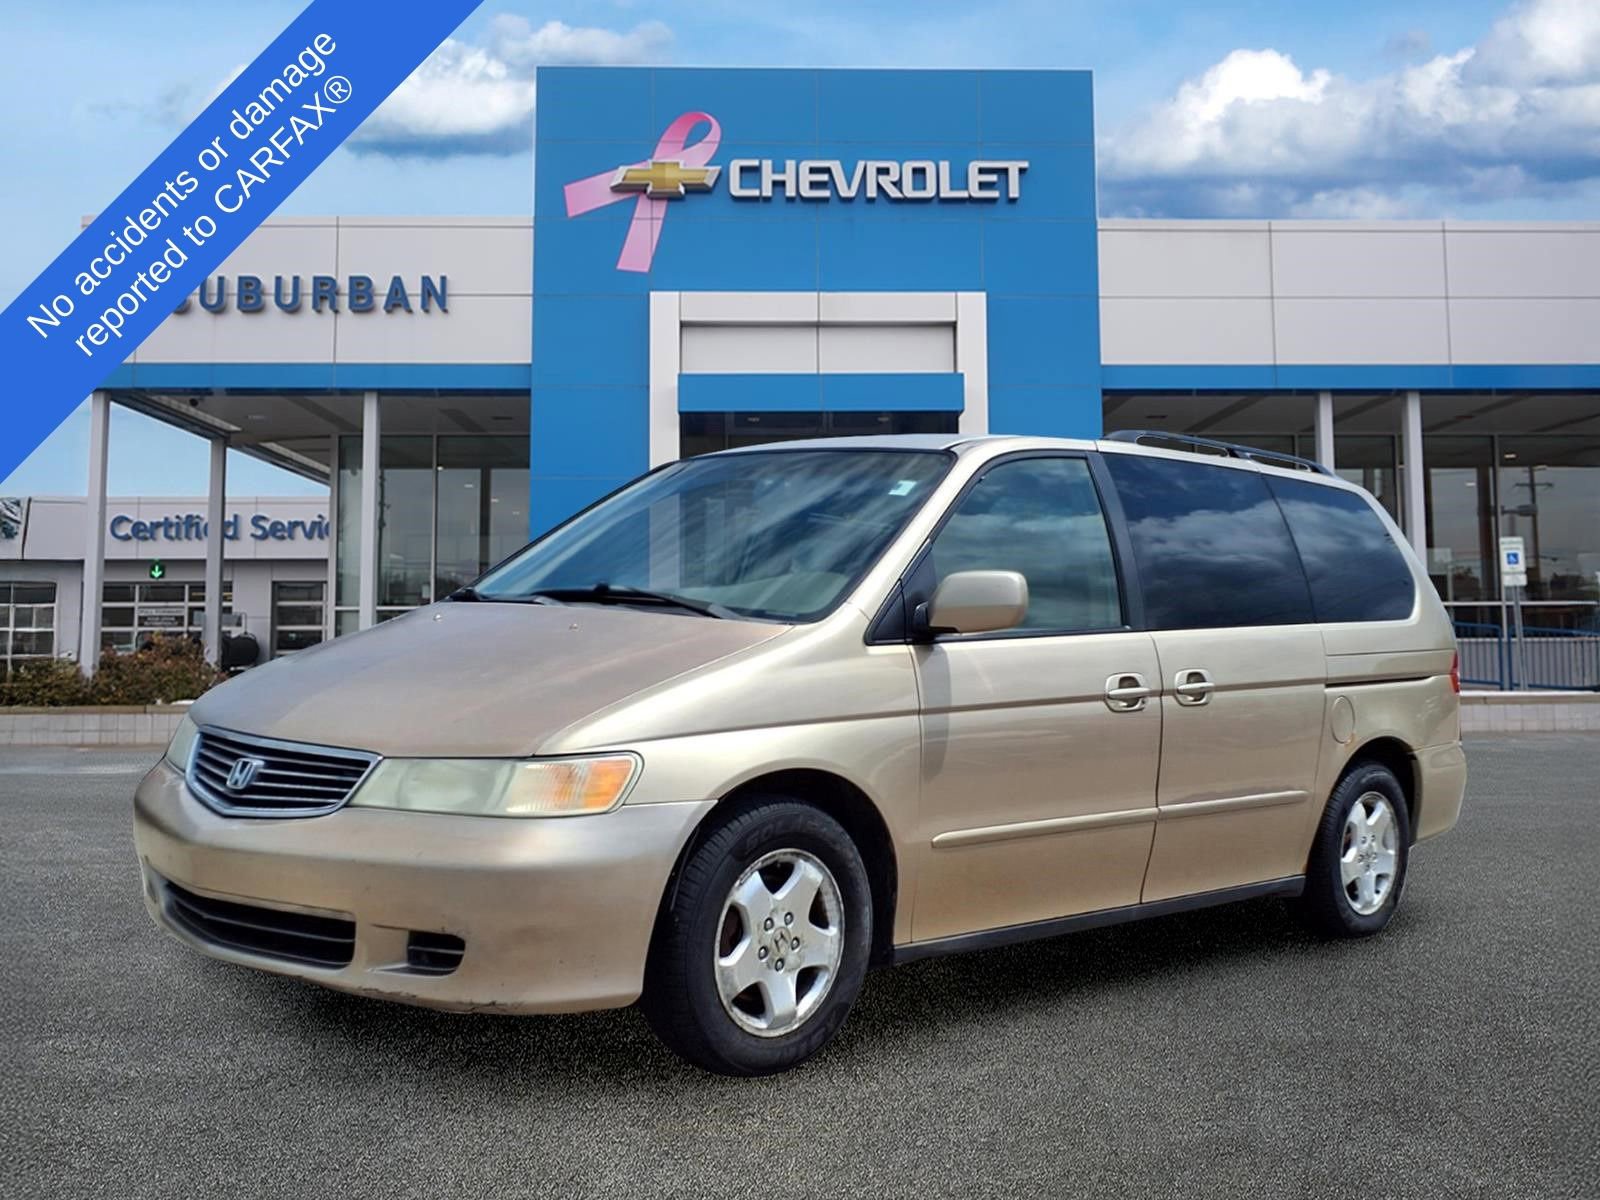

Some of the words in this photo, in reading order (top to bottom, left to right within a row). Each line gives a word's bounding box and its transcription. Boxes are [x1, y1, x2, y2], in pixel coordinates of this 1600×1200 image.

[728, 158, 1030, 202] CHEVROLET
[174, 275, 449, 313] UBURBAN
[109, 513, 239, 541] Certifid
[250, 514, 330, 541] Servi
